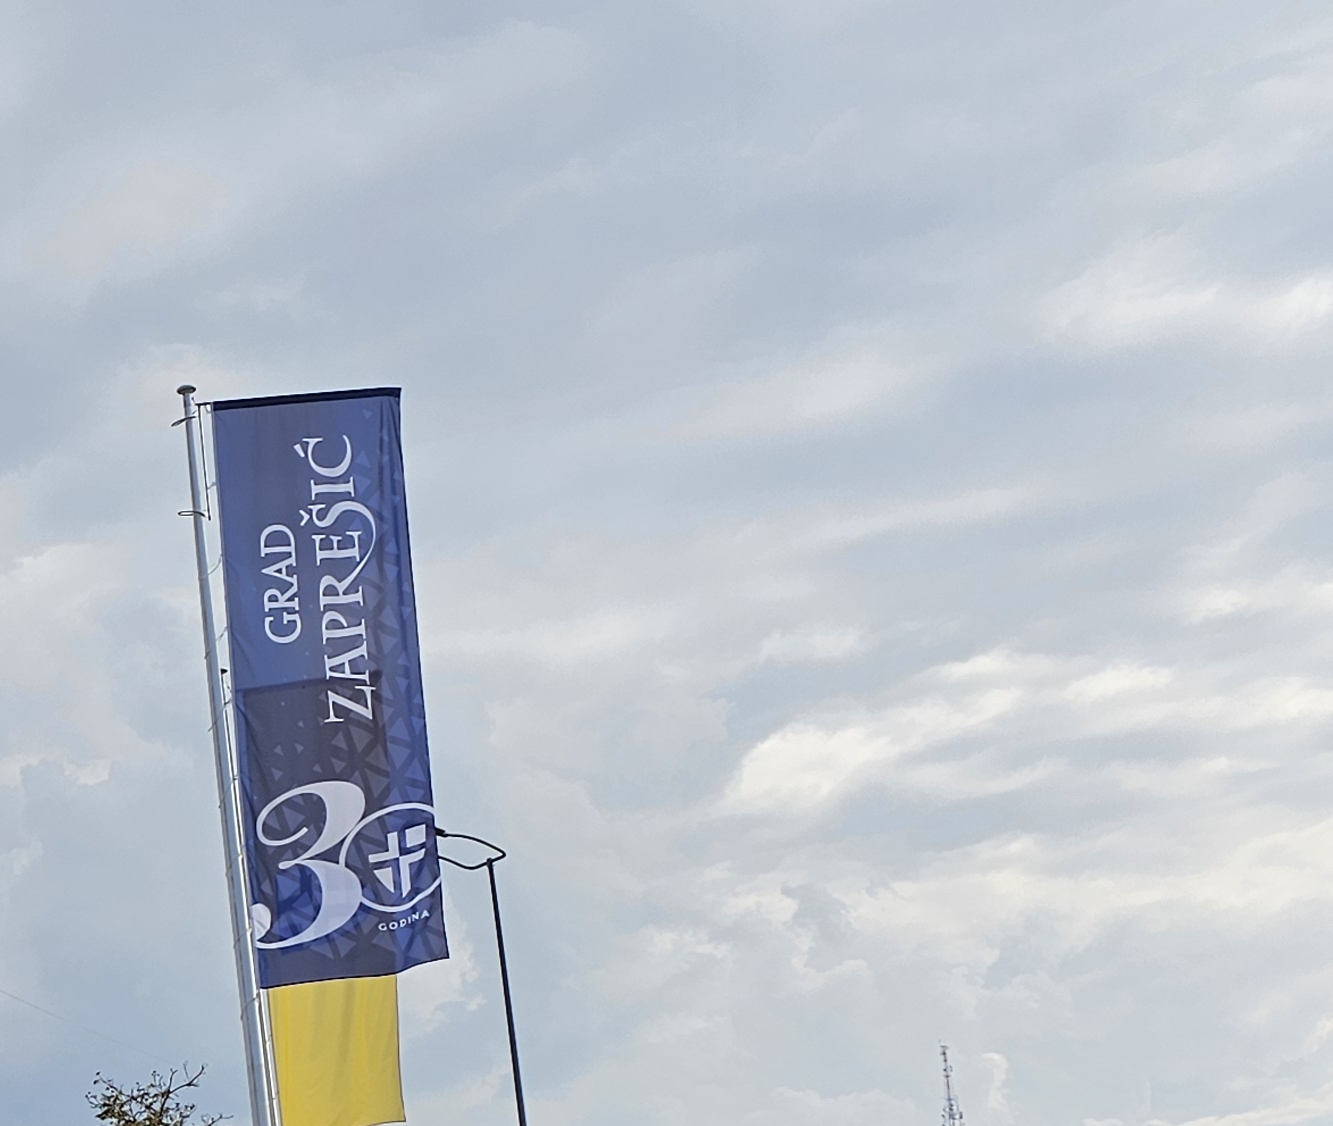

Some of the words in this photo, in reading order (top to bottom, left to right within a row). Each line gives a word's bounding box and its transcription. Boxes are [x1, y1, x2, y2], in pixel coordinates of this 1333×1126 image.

[260, 524, 303, 643] GRAD
[293, 434, 377, 724] ZAPREŠIĆ
[377, 909, 431, 932] GODINA
